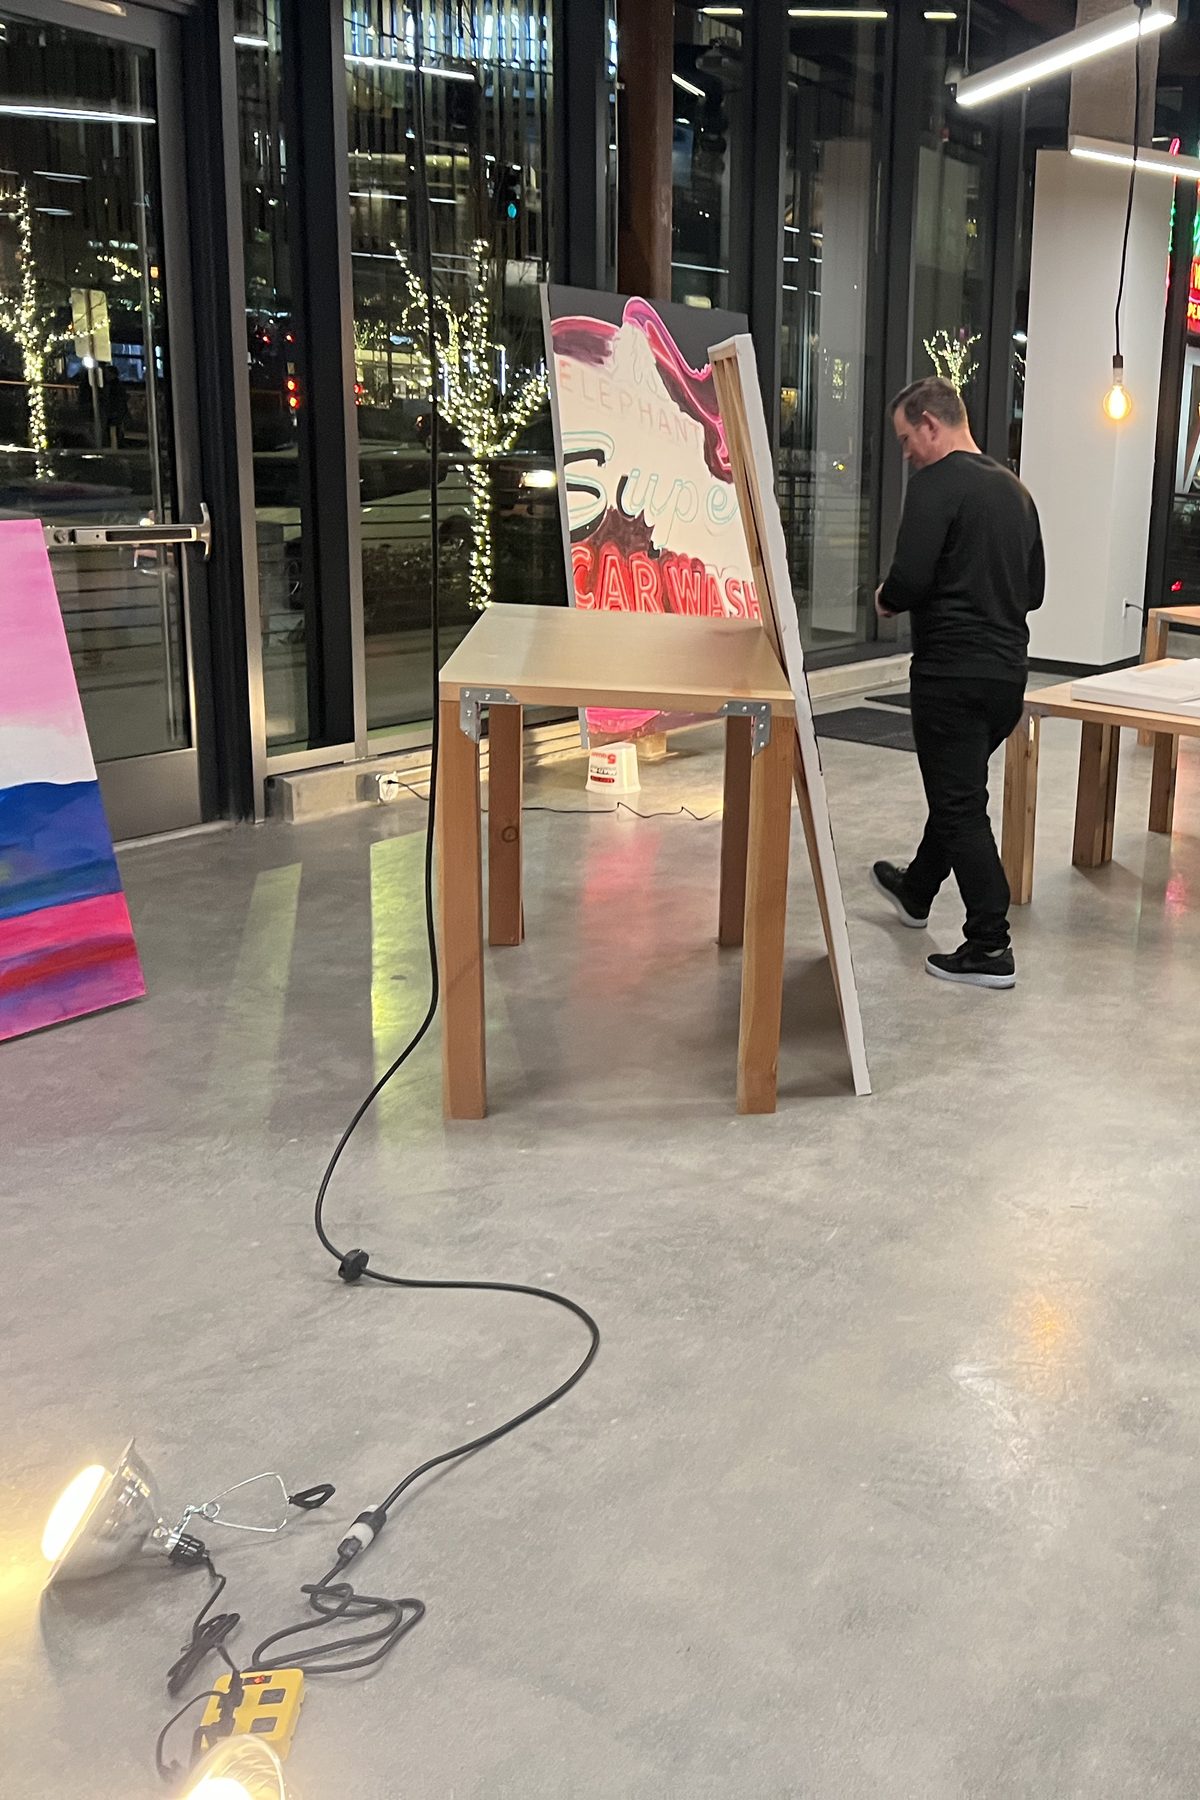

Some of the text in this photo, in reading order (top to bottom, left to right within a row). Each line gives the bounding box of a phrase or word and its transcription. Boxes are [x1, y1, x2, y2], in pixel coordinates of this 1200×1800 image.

[560, 359, 700, 449] ELEPHANT
[563, 430, 738, 548] Supe
[571, 545, 762, 621] CAR WASH
